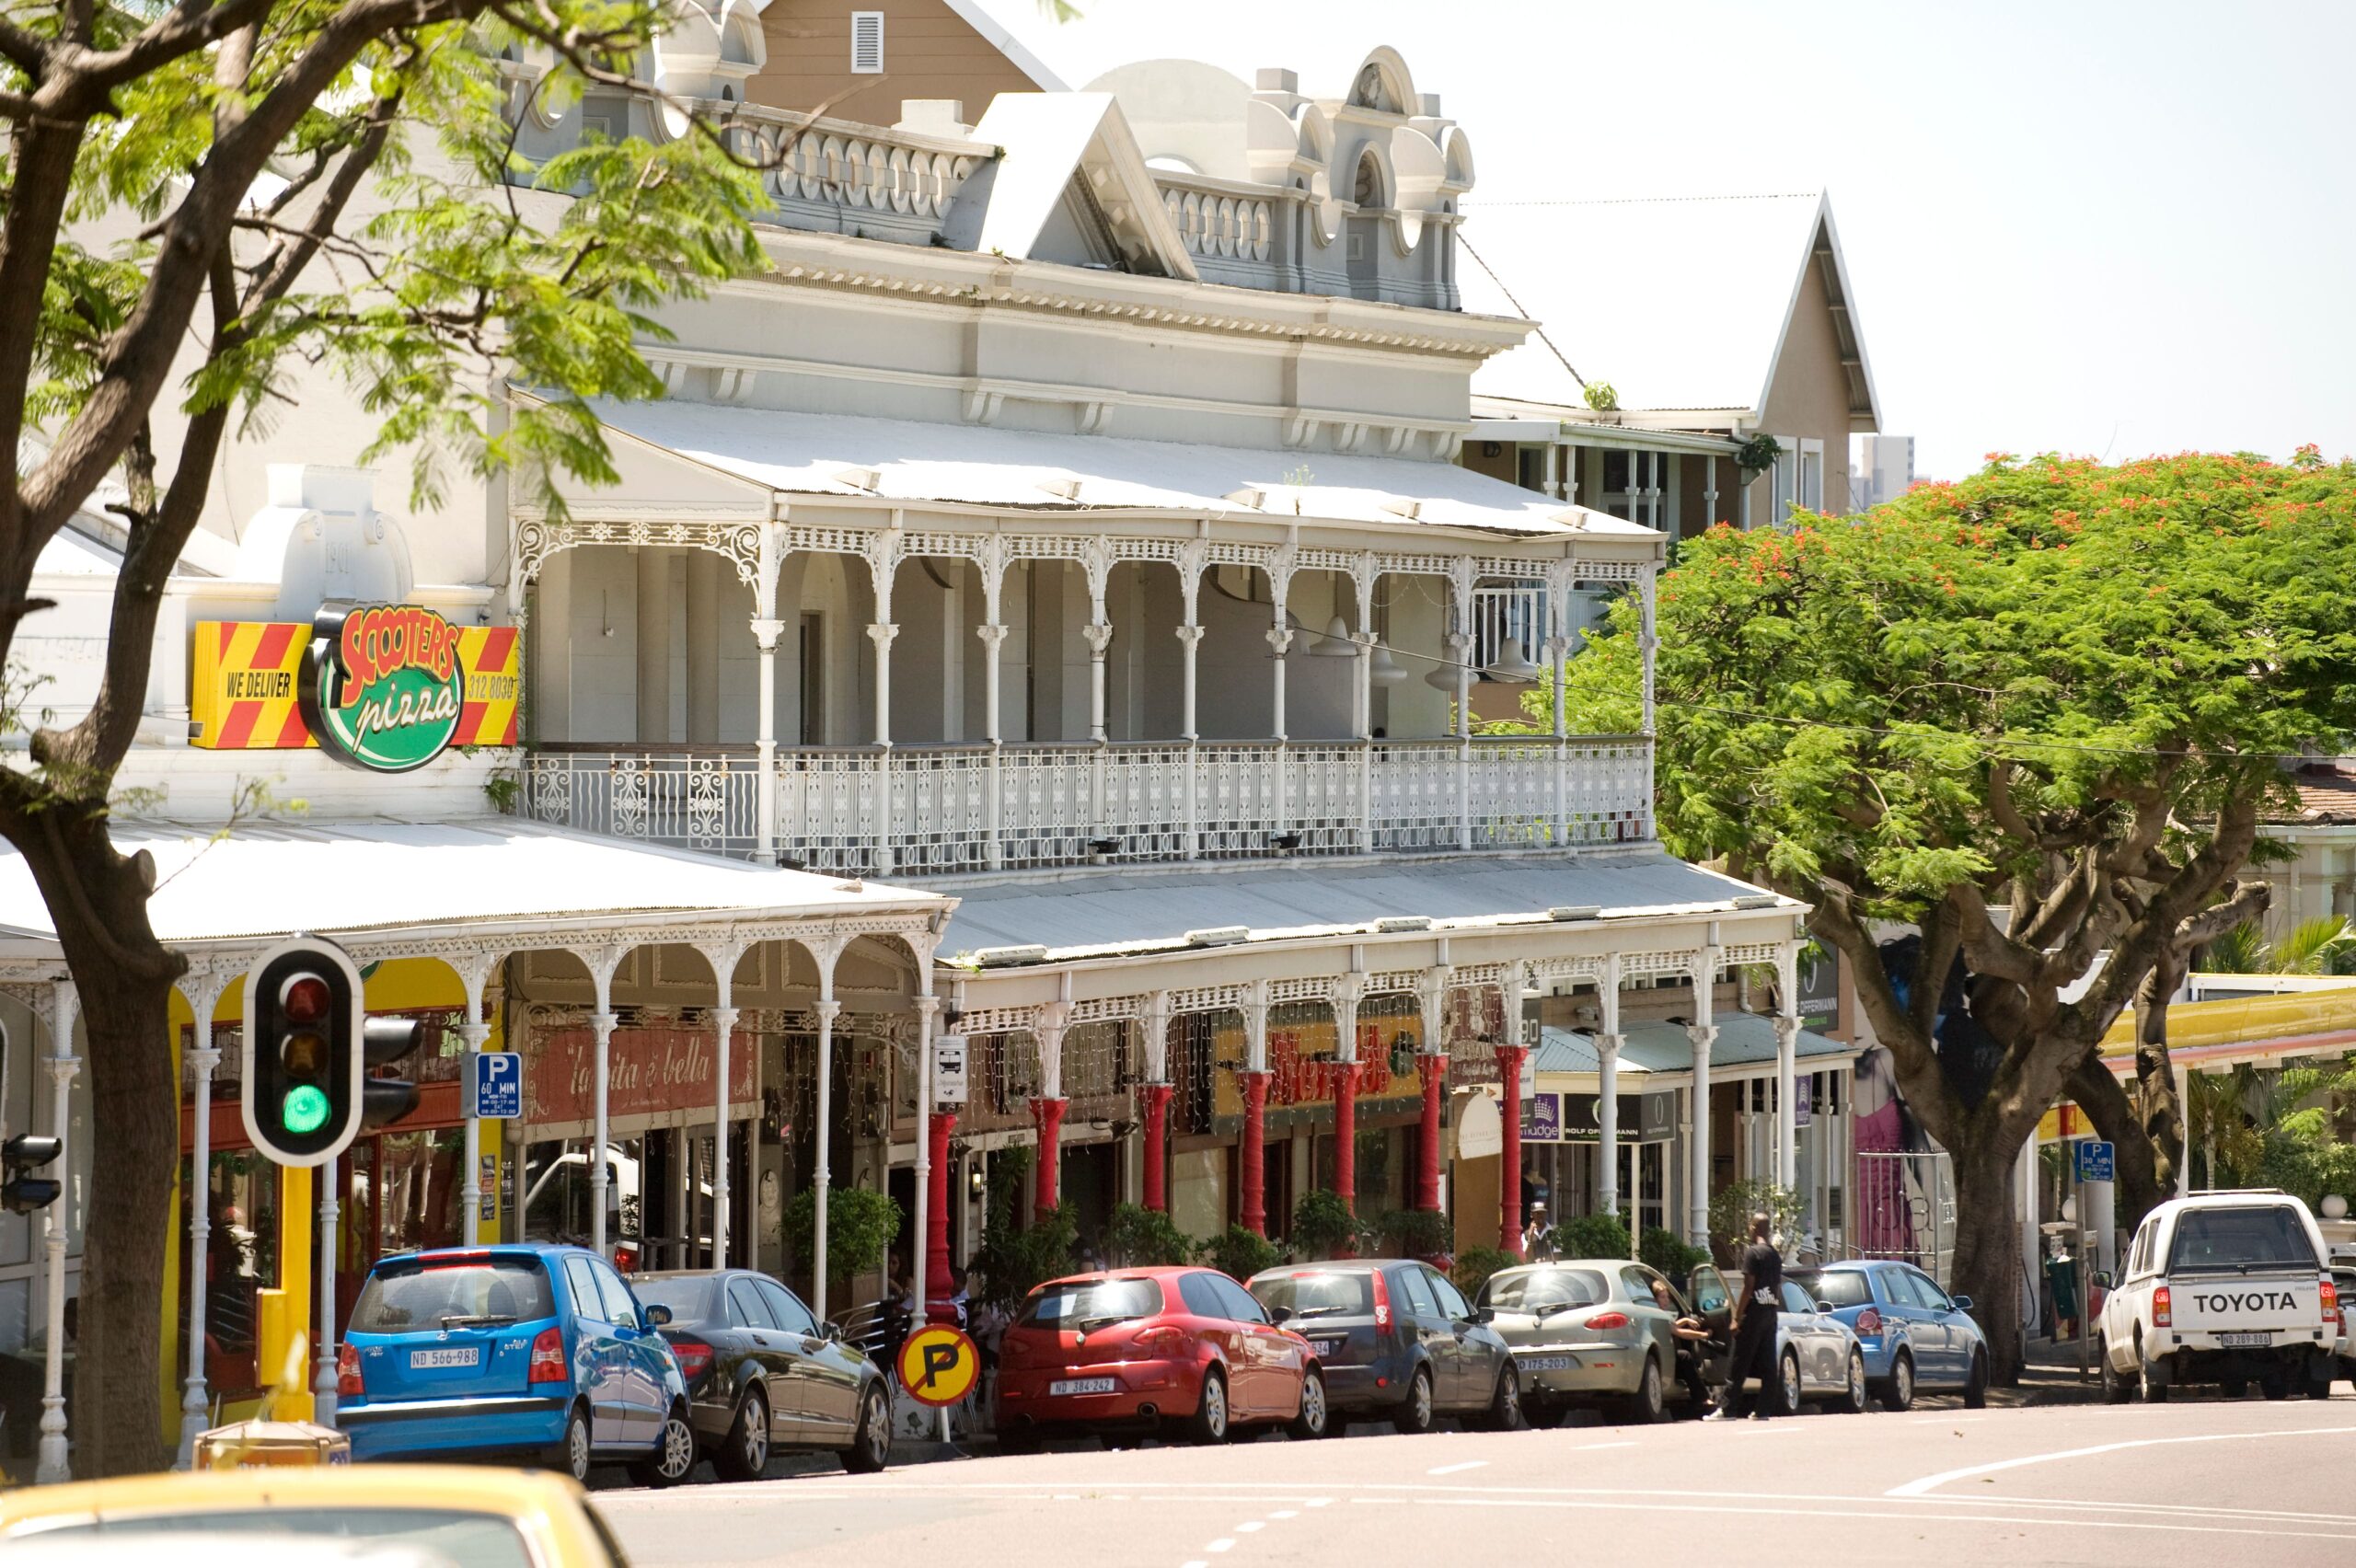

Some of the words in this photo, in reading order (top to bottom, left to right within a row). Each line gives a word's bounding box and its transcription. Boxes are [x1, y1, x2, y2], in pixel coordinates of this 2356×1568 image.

[341, 606, 459, 709] SCOOTERS
[226, 672, 243, 698] WE
[246, 672, 290, 698] DELIVER
[468, 675, 486, 698] 312
[490, 675, 513, 699] 8030
[352, 683, 458, 754] pizza
[490, 1055, 509, 1082] P
[607, 1053, 640, 1090] ita
[663, 1036, 711, 1085] bella
[480, 1082, 492, 1094] 60
[499, 1082, 515, 1094] MIN
[2092, 1144, 2103, 1158] P
[2193, 1292, 2298, 1313] TOYOTA
[2223, 1334, 2234, 1344] ND
[412, 1351, 427, 1366] ND
[432, 1349, 478, 1366] 566-988
[923, 1343, 959, 1388] P
[1056, 1382, 1068, 1393] ND
[1073, 1380, 1110, 1392] 384-242
